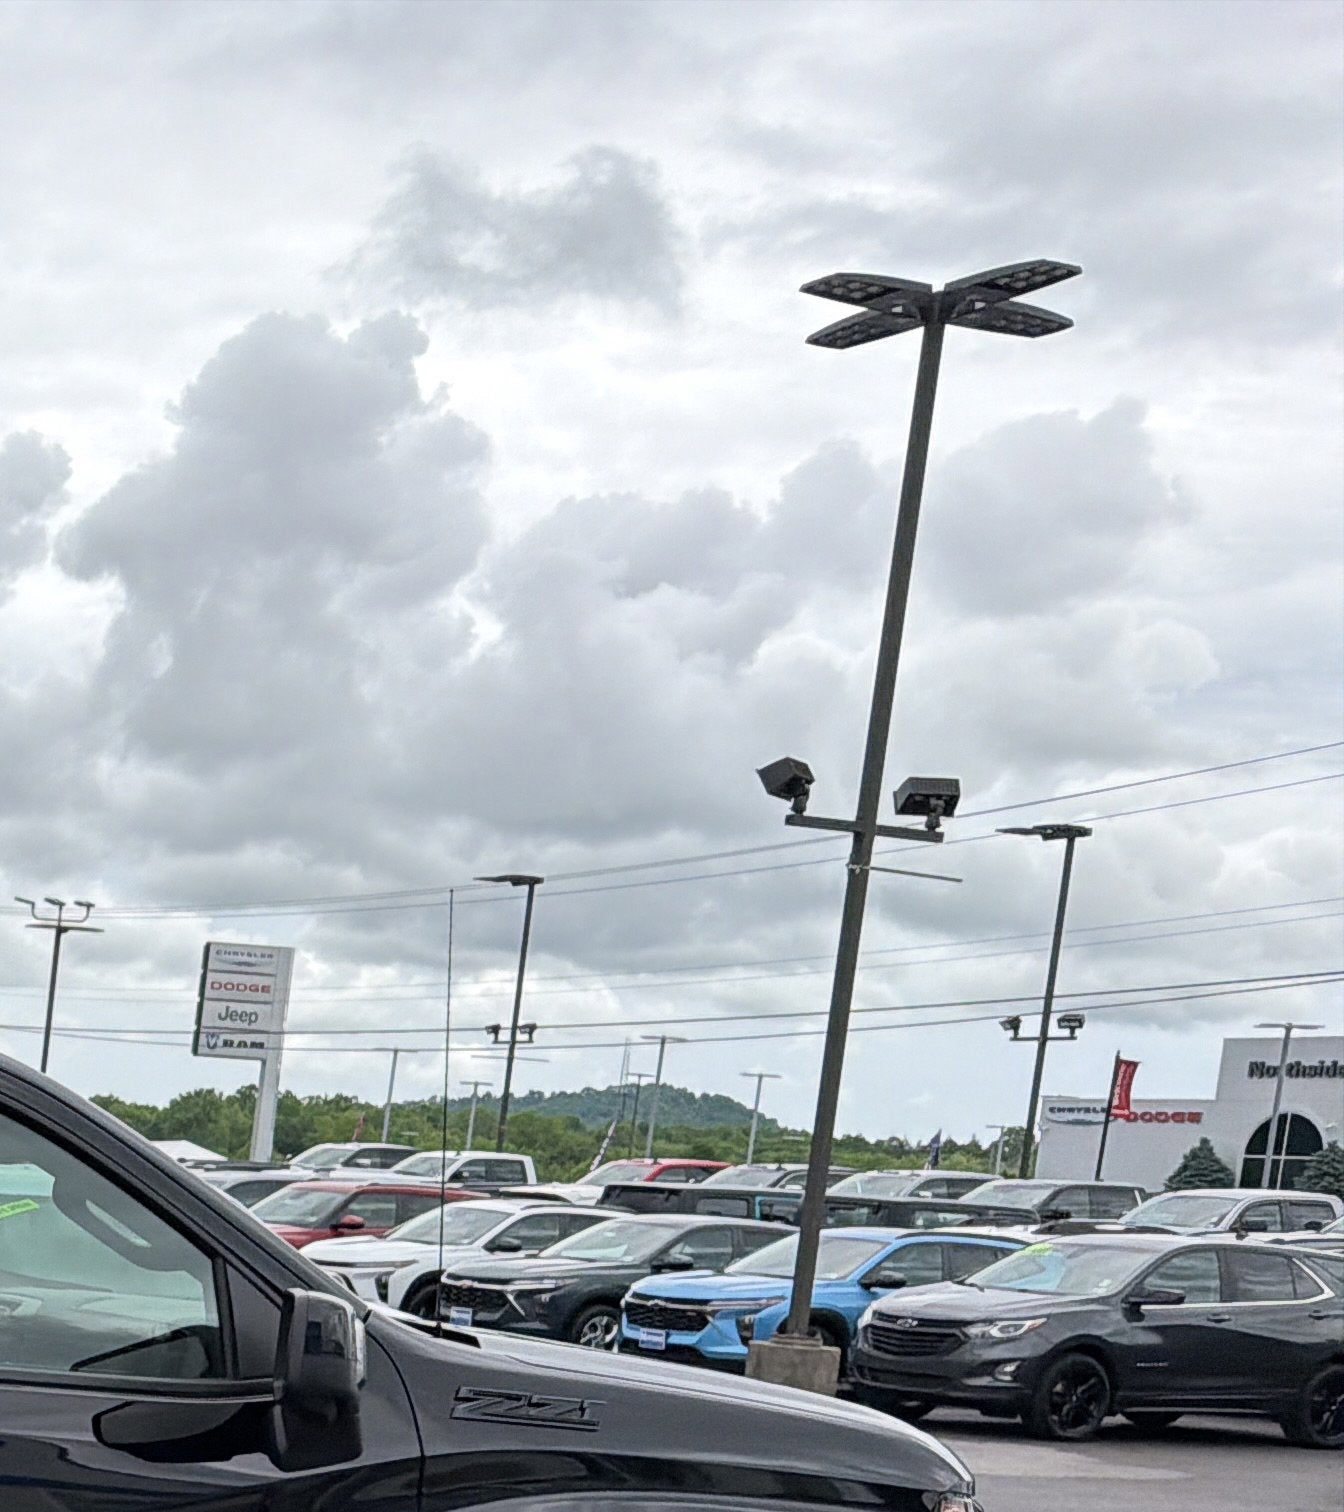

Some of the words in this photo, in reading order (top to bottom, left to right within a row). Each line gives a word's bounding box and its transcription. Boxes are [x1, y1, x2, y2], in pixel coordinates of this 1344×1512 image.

[215, 949, 274, 959] CHRYSLER
[210, 981, 271, 994] DODGE
[217, 1005, 259, 1026] Jeep
[222, 1038, 265, 1050] RAM
